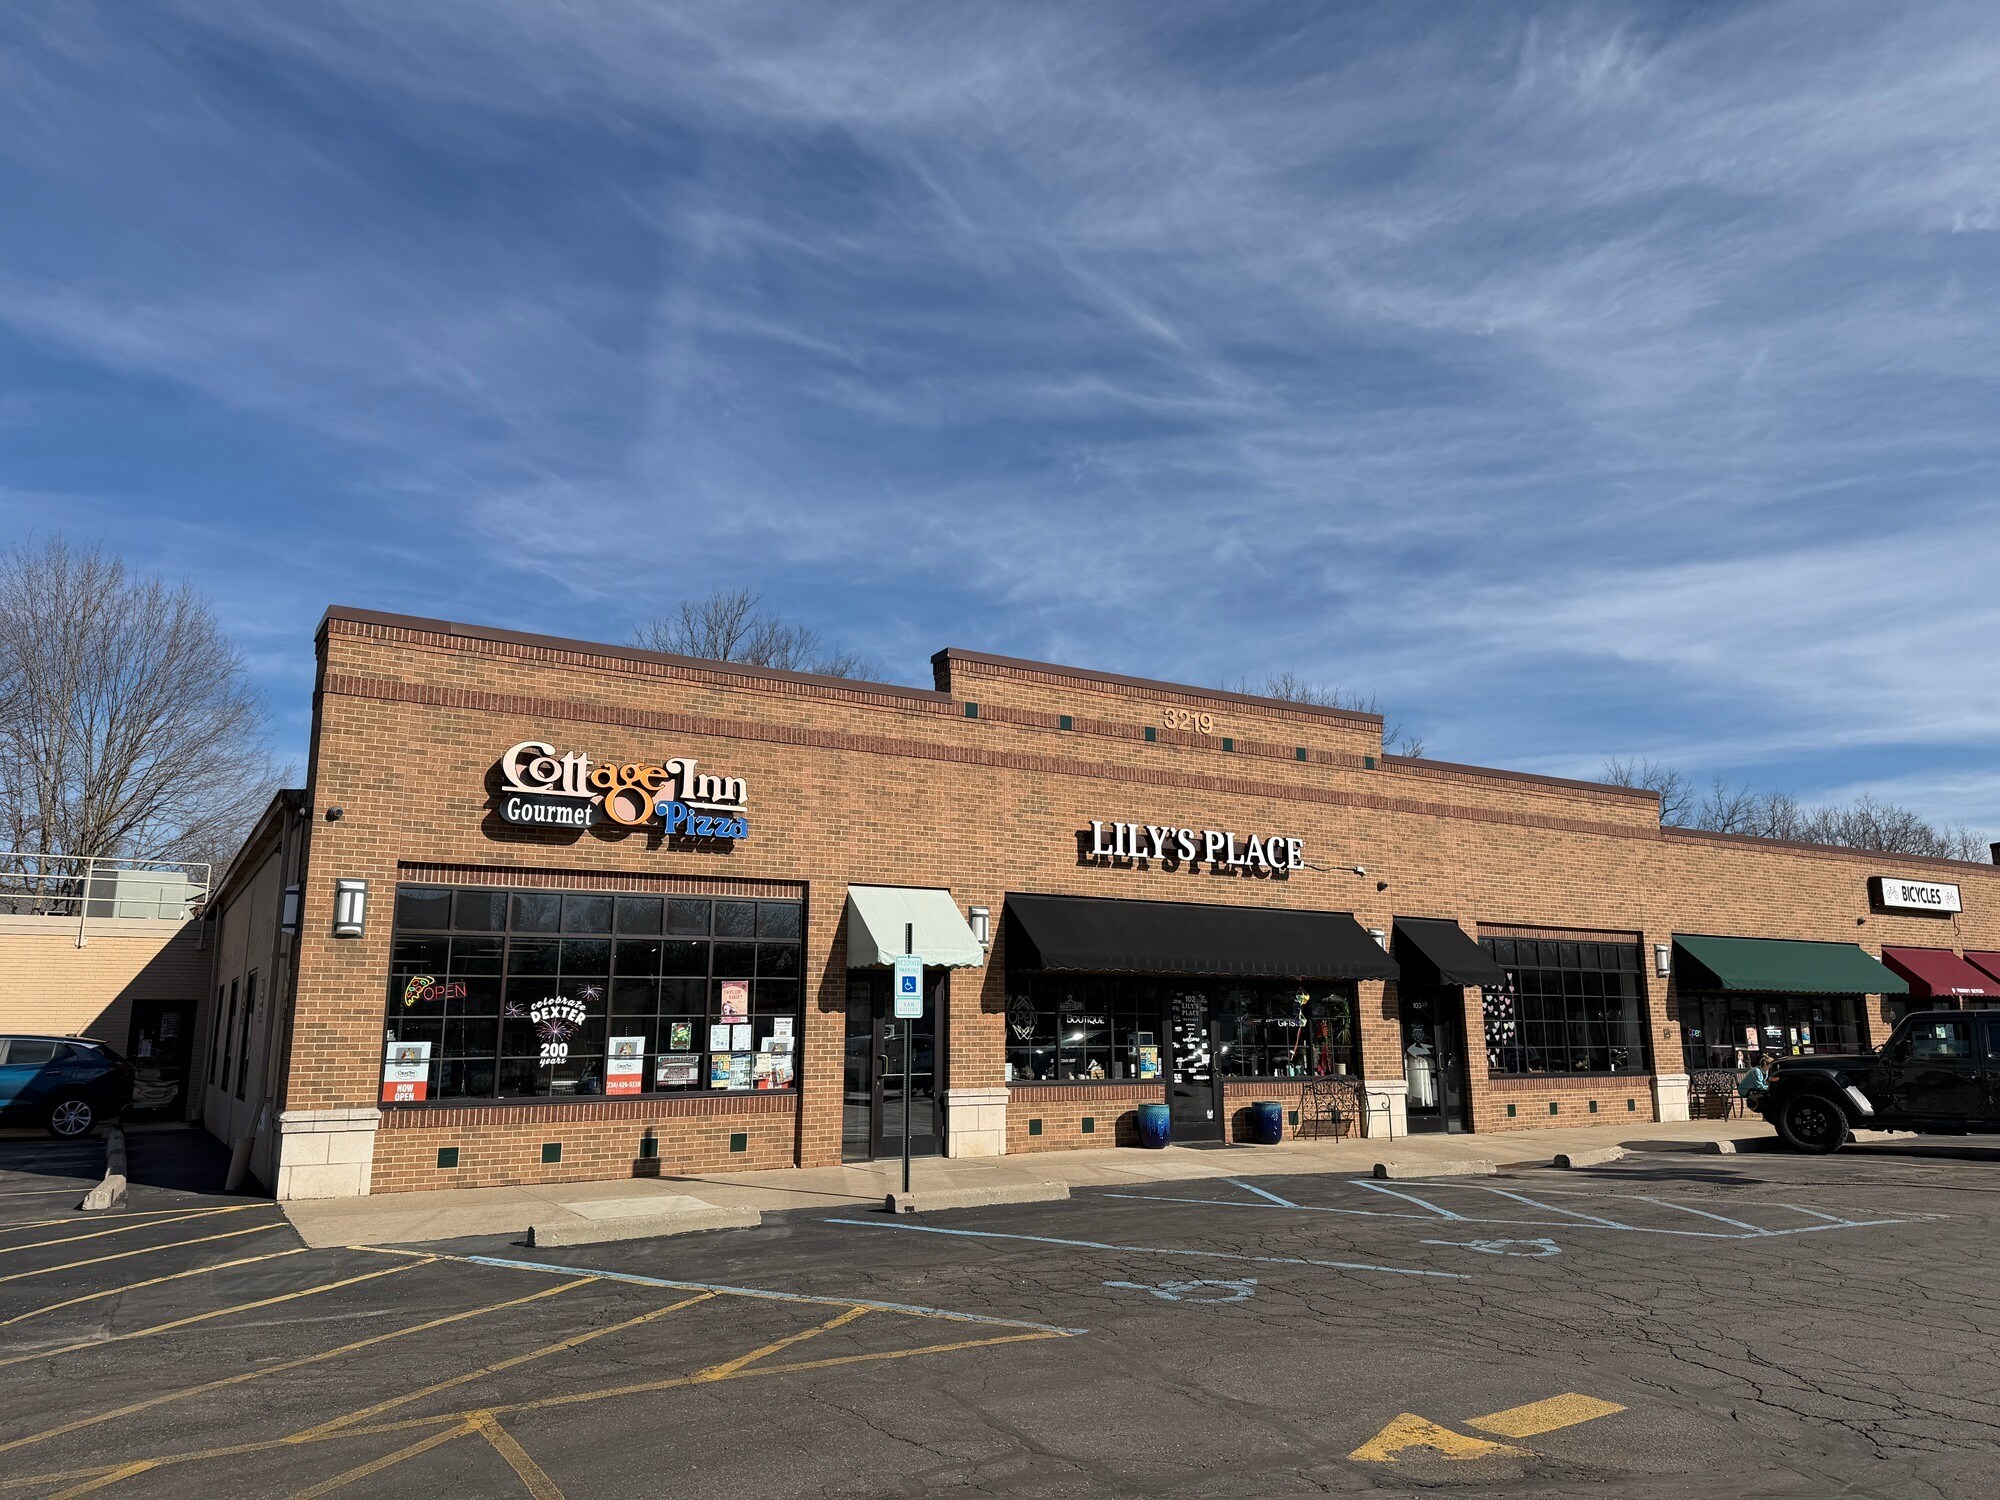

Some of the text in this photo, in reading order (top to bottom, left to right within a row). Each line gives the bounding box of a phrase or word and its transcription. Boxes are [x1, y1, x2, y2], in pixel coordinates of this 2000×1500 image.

[1164, 708, 1213, 735] 3219
[502, 741, 748, 826] Cottage Inn
[507, 797, 593, 827] Gourmet
[655, 801, 748, 840] Pizza
[1092, 820, 1305, 870] LILY'S PLACE
[1901, 885, 1942, 905] BICYCLES
[423, 984, 467, 1001] OPEN
[530, 1006, 586, 1026] DEXTER
[540, 1042, 568, 1057] 200
[539, 1057, 567, 1069] years
[394, 1092, 415, 1102] OPEN
[396, 1084, 414, 1093] NOW
